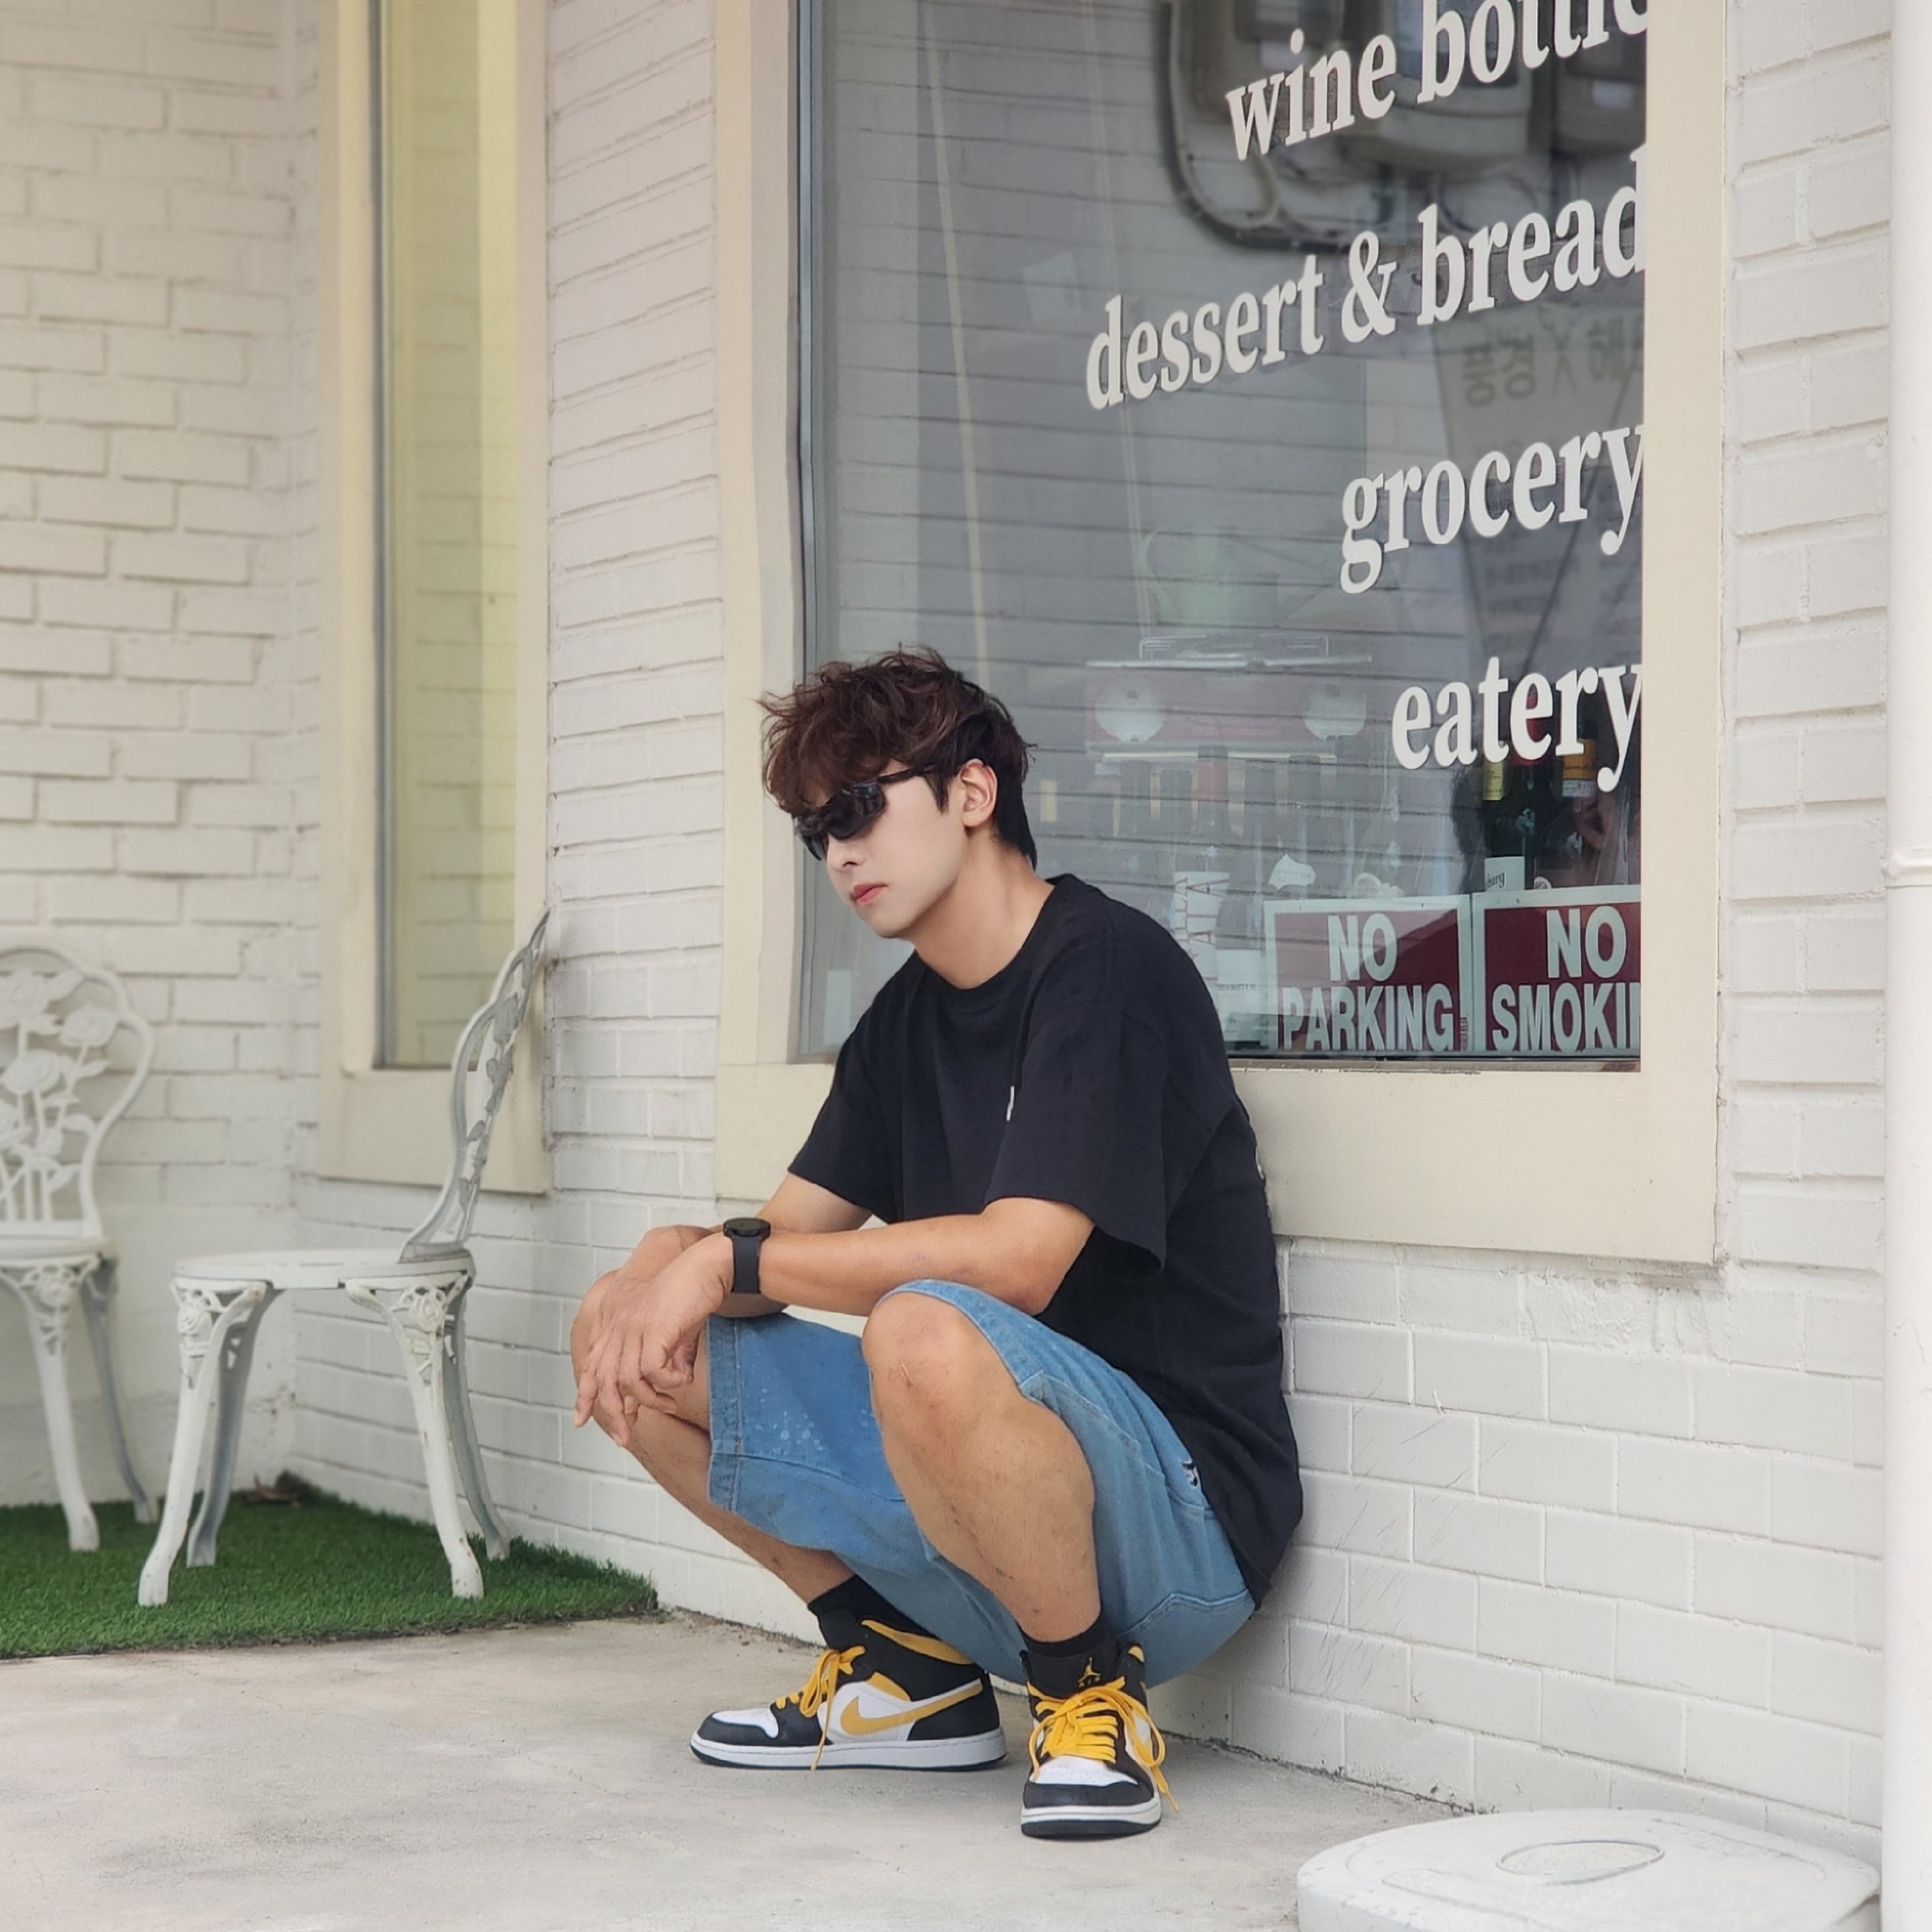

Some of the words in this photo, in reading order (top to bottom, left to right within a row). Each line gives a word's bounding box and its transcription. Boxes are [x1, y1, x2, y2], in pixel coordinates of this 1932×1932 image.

[1226, 29, 1396, 160] wine
[1087, 255, 1323, 409] dessert
[1342, 231, 1397, 342] &
[1417, 145, 1646, 326] bread
[1340, 424, 1644, 593] grocery
[1391, 657, 1642, 793] eatery
[1328, 913, 1398, 982] NO
[1546, 905, 1627, 978] NO
[1282, 983, 1453, 1051] PARKING
